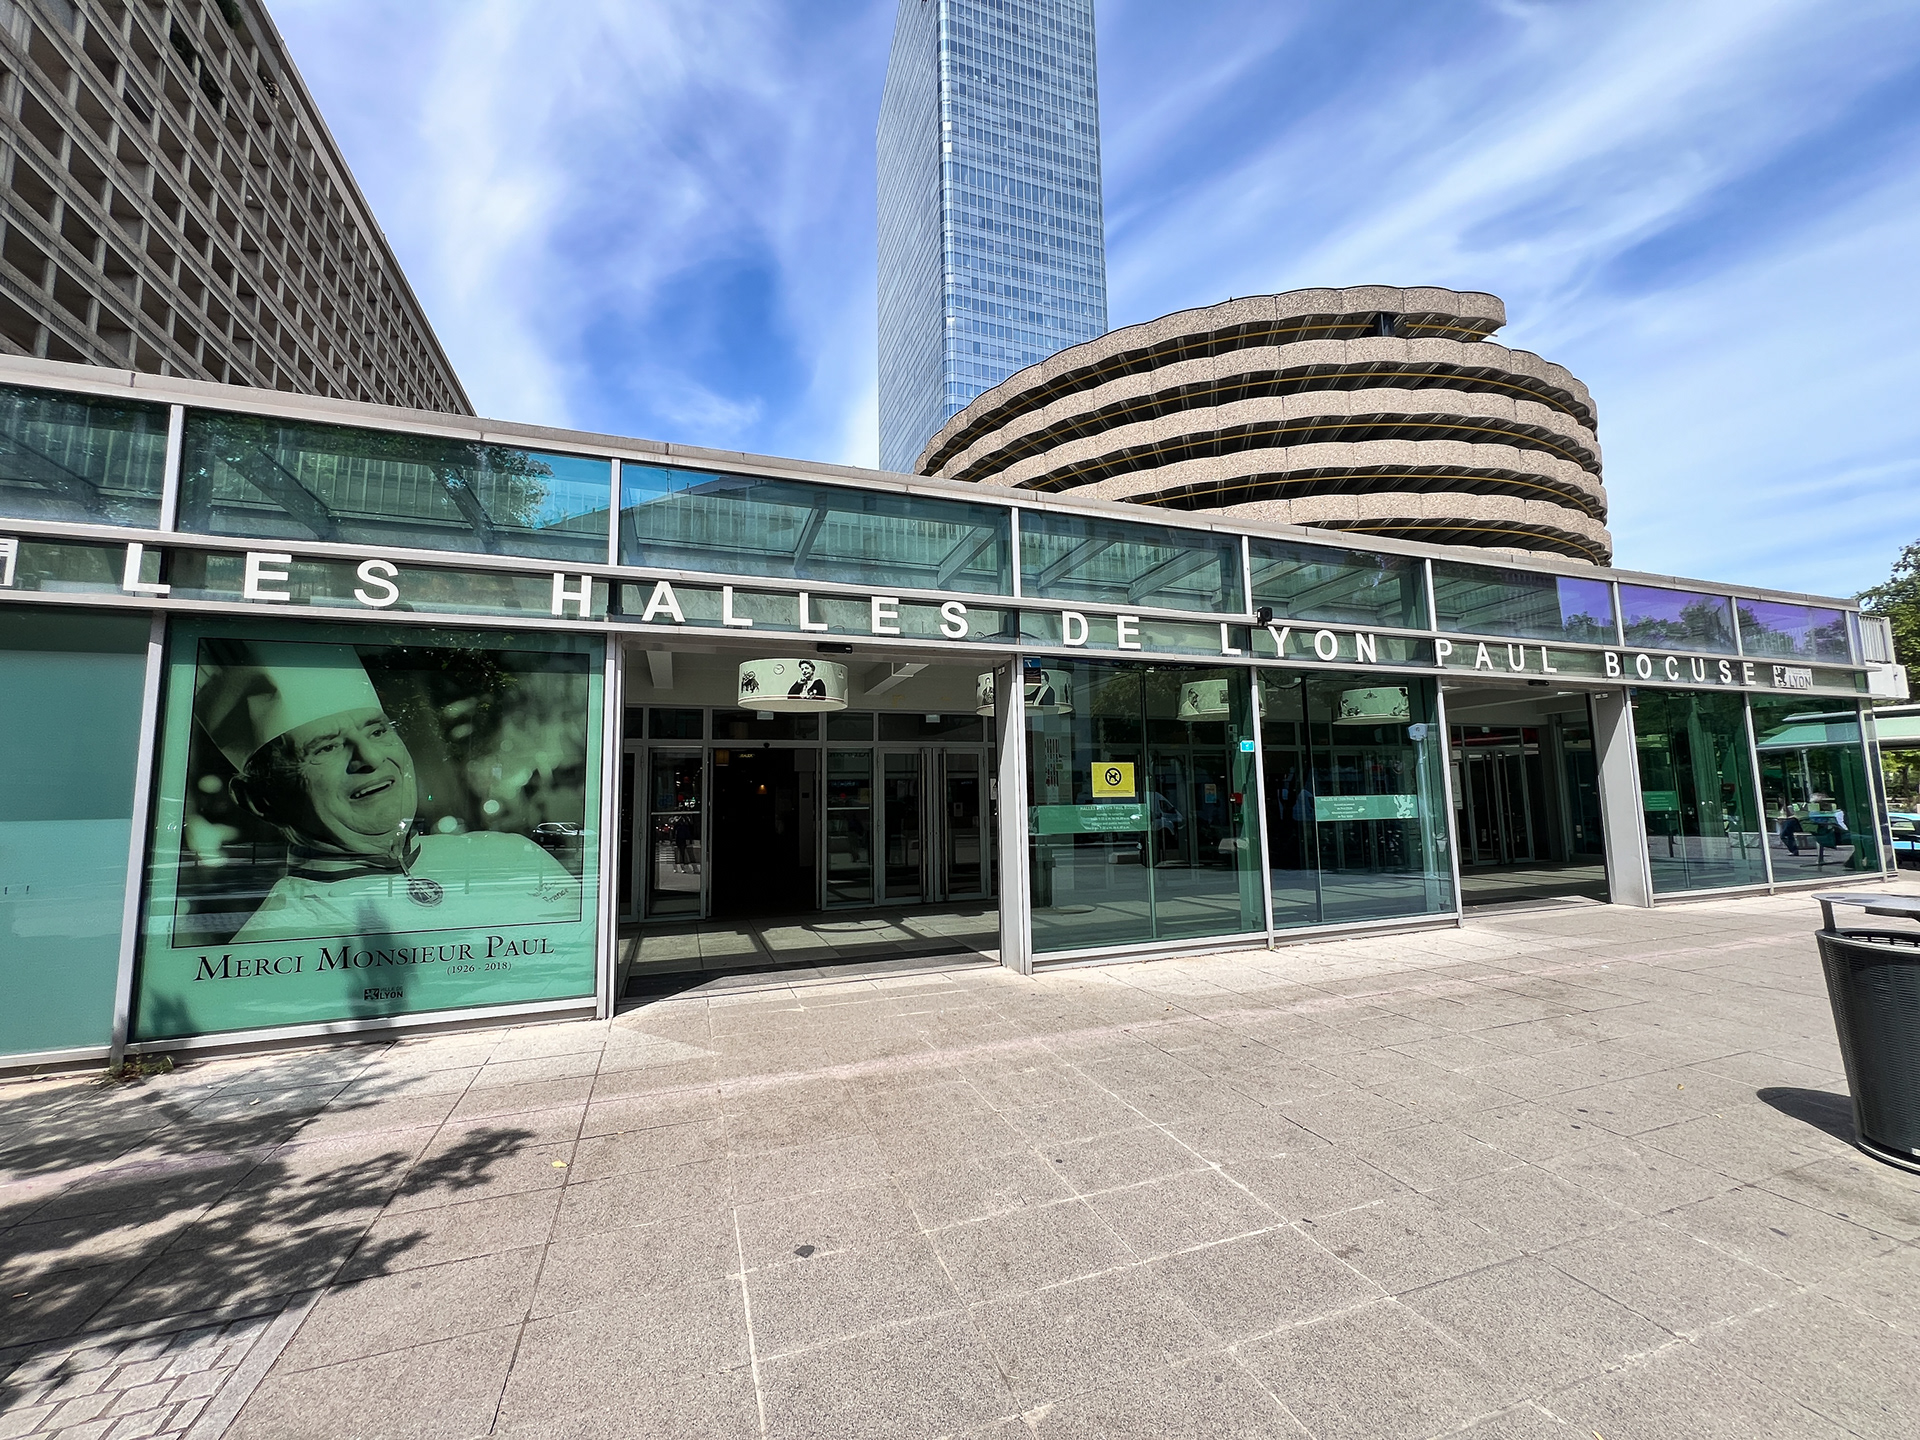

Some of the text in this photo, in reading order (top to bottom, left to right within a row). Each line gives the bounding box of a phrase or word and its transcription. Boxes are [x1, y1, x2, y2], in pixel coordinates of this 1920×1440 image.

[123, 543, 1757, 686] LES HALLES DE LYON PAUL BOCUSE
[1788, 674, 1811, 688] LYON
[380, 991, 404, 1000] LYON
